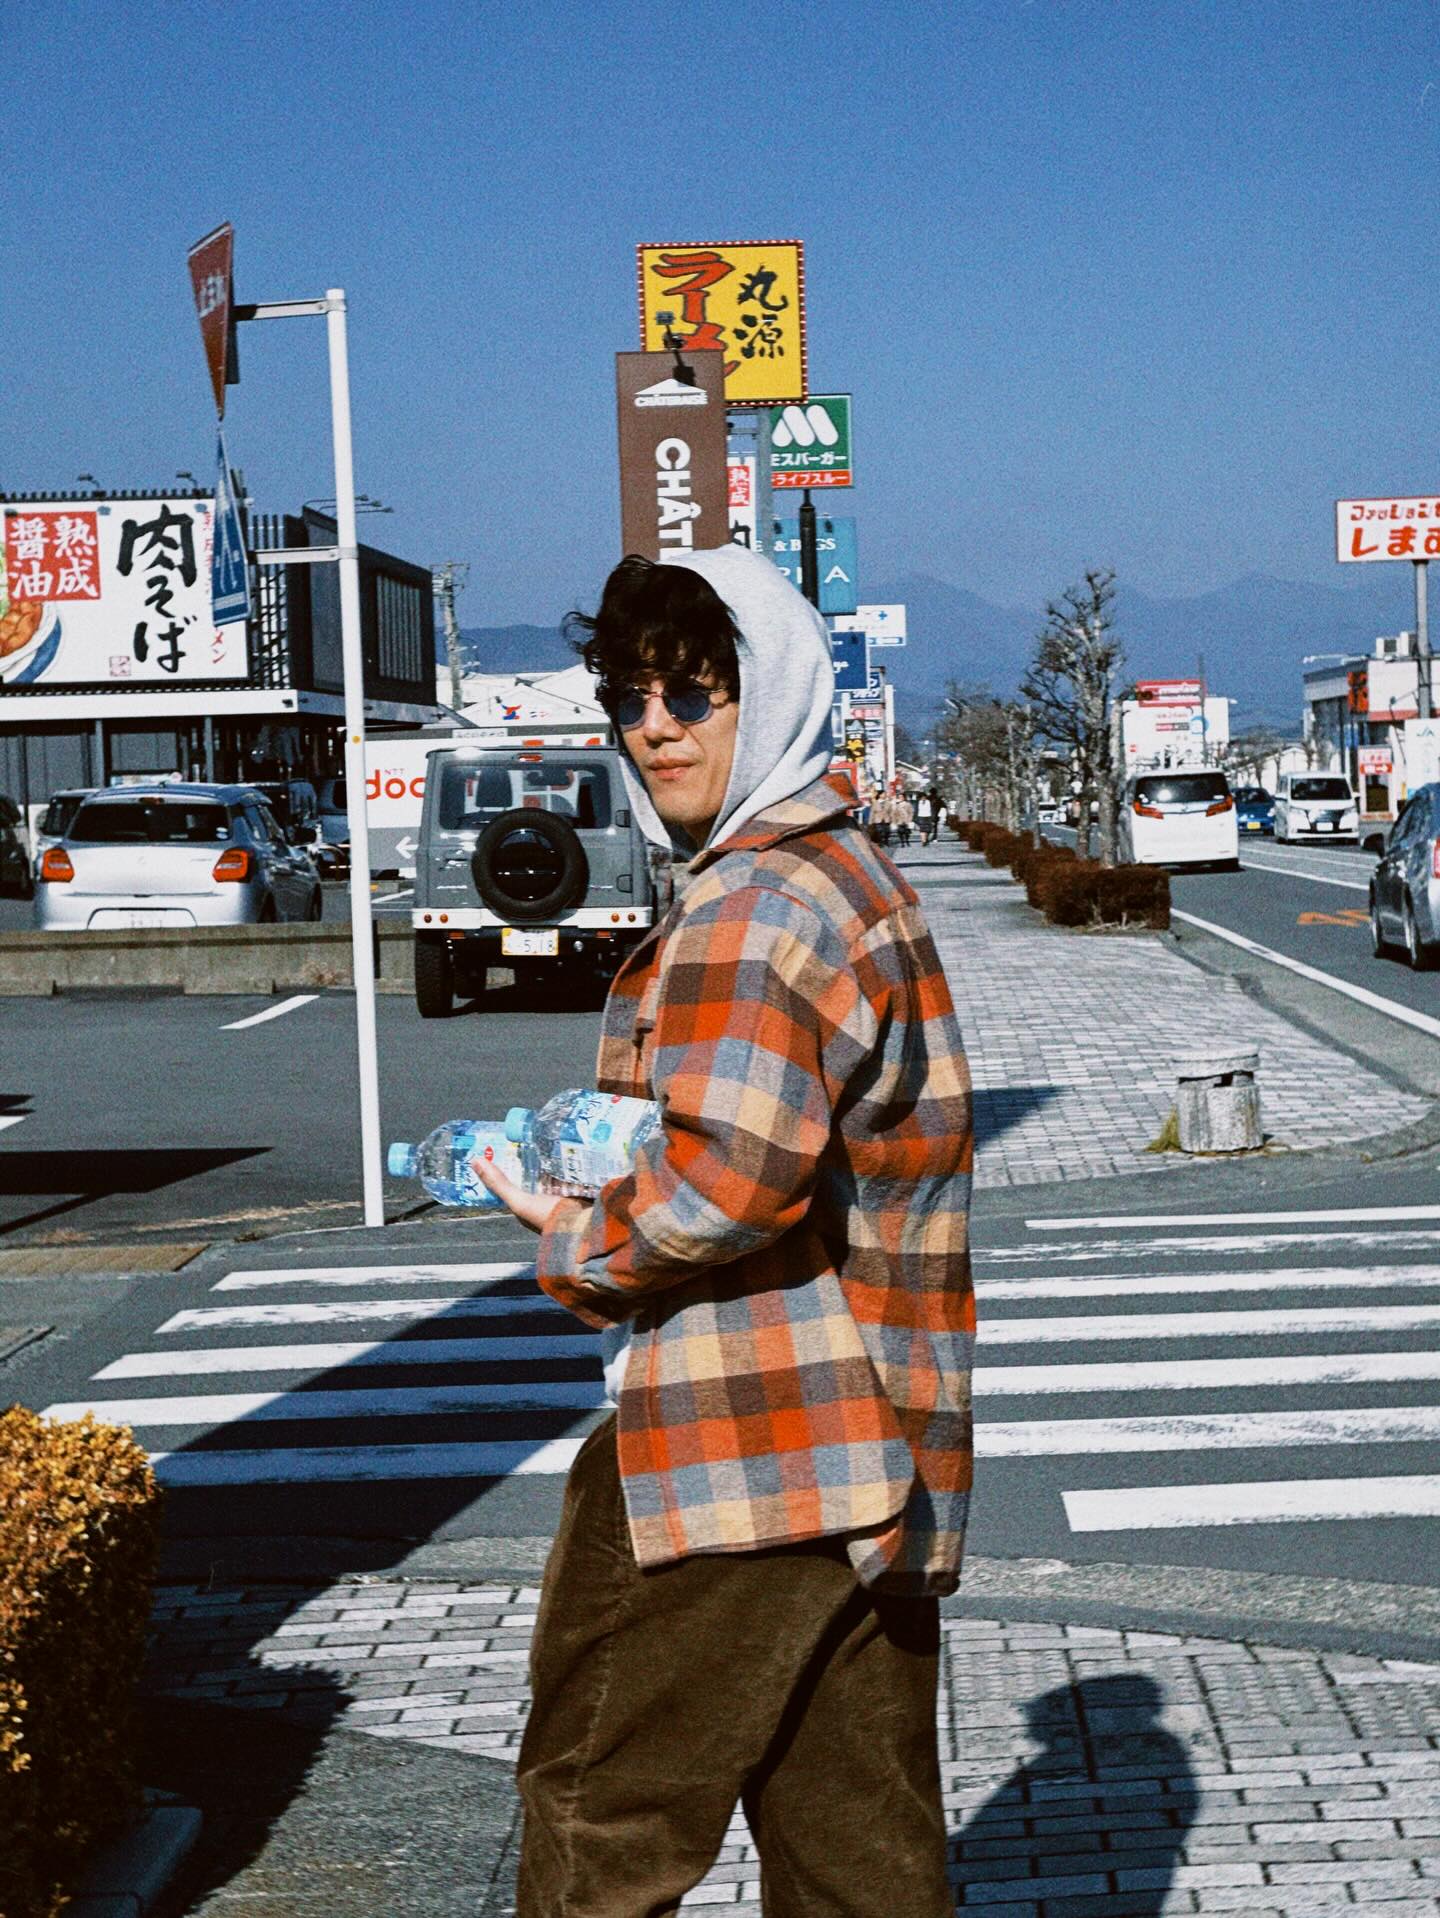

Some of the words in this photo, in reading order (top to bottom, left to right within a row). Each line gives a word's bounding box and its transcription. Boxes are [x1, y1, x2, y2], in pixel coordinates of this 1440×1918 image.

[733, 264, 789, 359] 丸源
[770, 472, 849, 486] ライブスルー
[8, 516, 53, 599] 醤油
[53, 515, 99, 597] 熟成
[790, 538, 836, 552] BGS
[116, 503, 198, 674] 肉そば
